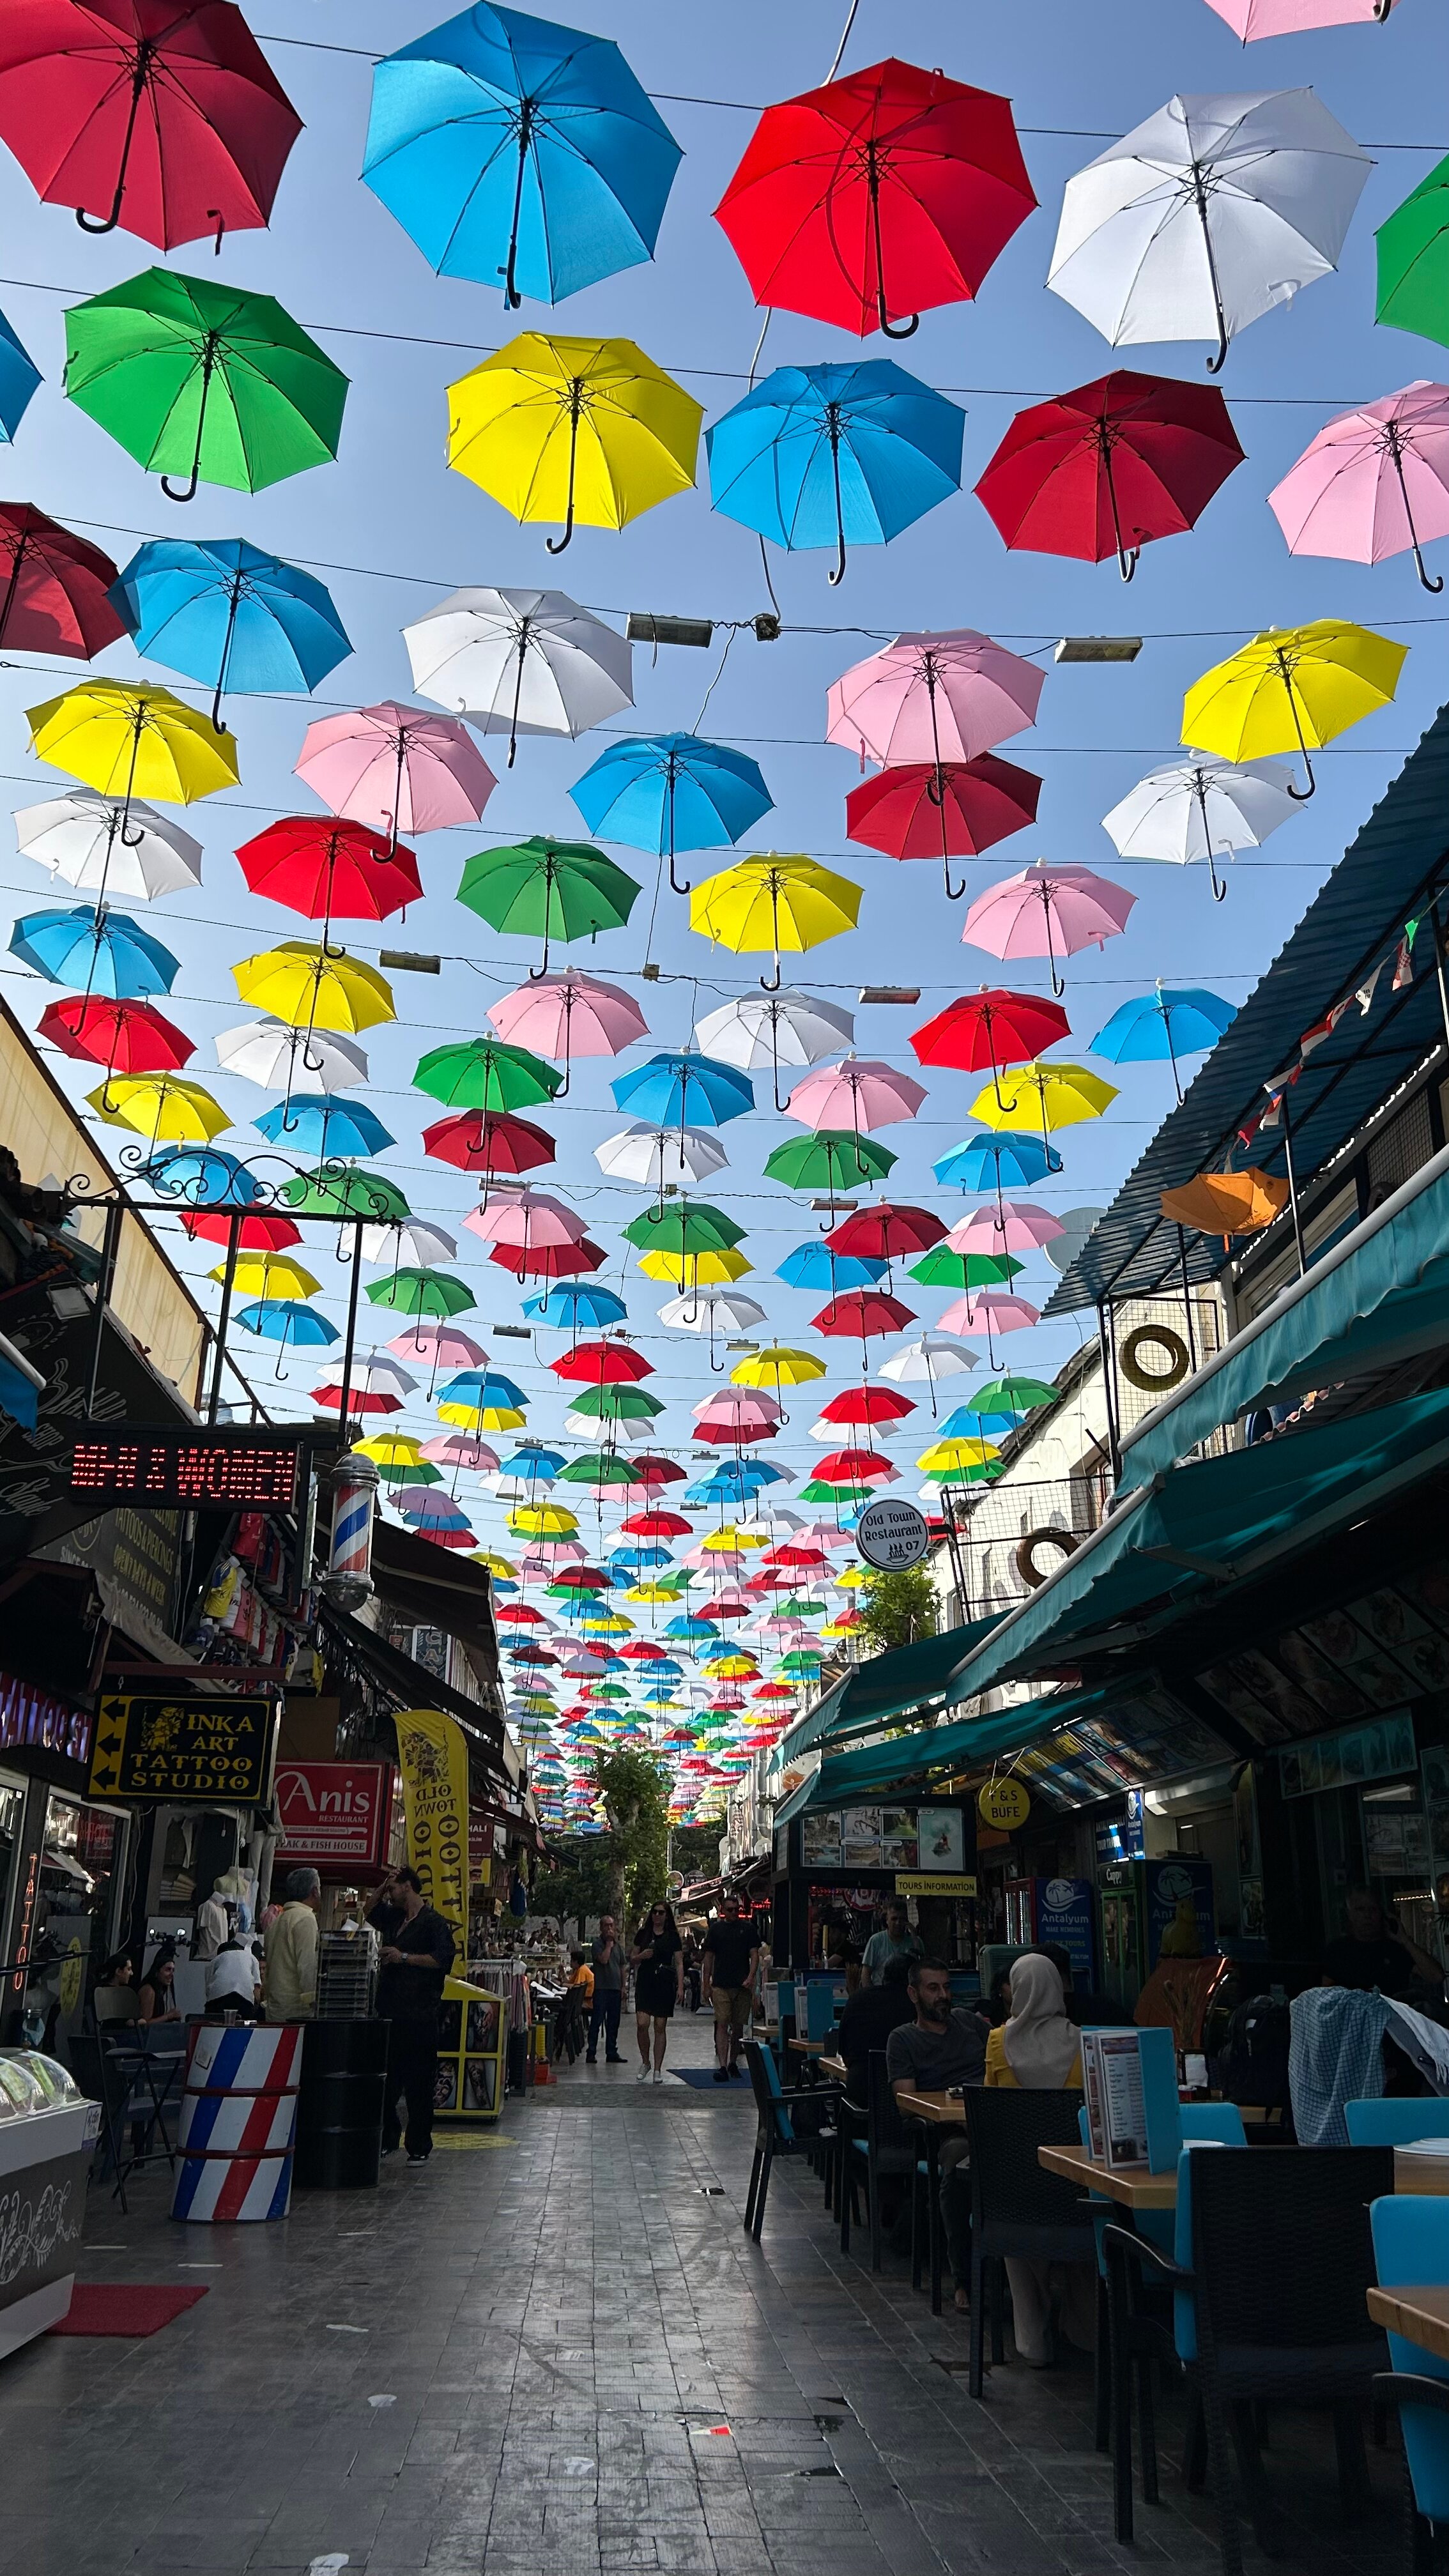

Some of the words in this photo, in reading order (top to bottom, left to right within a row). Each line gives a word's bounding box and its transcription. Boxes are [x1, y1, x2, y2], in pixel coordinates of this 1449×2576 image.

[176, 1447, 295, 1501] WOMEN
[866, 1515, 884, 1526] Old
[887, 1512, 916, 1523] Town
[864, 1524, 923, 1542] Restaurant
[905, 1540, 919, 1551] 07
[187, 1713, 255, 1734] INKA
[191, 1736, 239, 1752] ART
[130, 1753, 253, 1772] TATTOO
[130, 1772, 250, 1790] STUDIO
[273, 1770, 371, 1813] Anis
[1000, 1790, 1008, 1801] &
[1011, 1790, 1018, 1801] S
[991, 1804, 1021, 1818] BÜFE
[318, 1814, 369, 1823] RESTAURANT
[301, 1840, 308, 1848] &
[310, 1841, 332, 1850] FISH
[334, 1842, 365, 1850] HOUSE
[898, 1881, 923, 1890] TOURS
[1041, 1913, 1089, 1925] Antalyum
